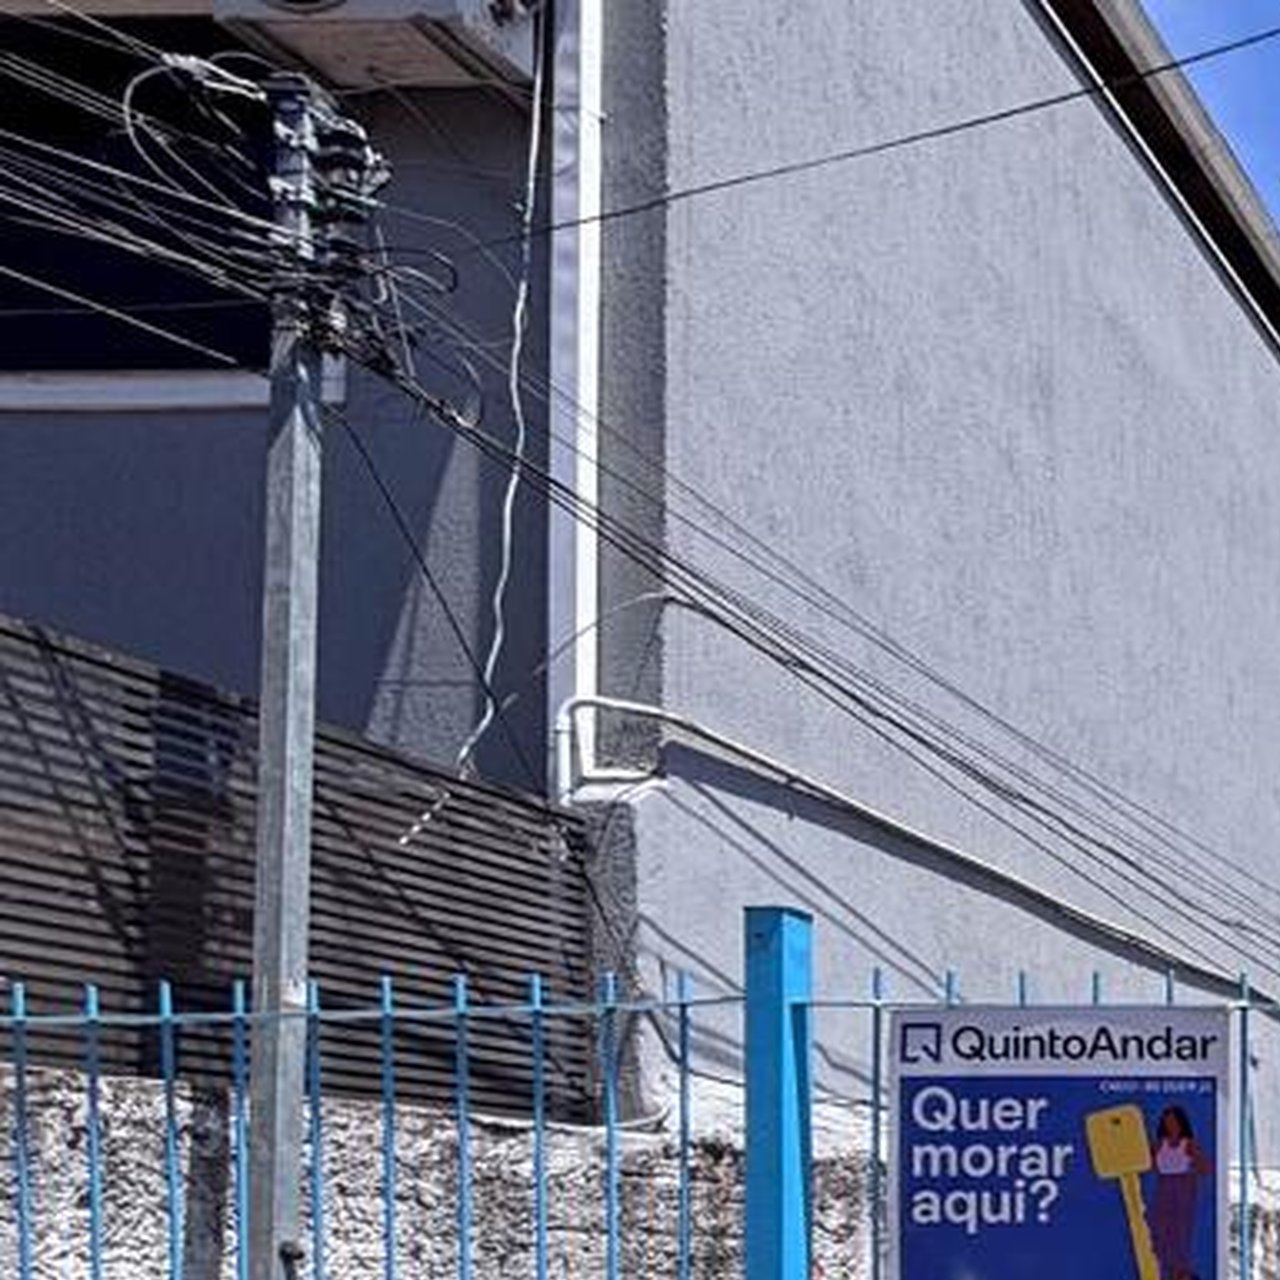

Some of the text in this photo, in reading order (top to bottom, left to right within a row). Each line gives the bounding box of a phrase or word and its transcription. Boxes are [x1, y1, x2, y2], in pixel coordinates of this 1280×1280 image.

[951, 1025, 1219, 1062] QuintoAndar
[912, 1086, 1048, 1132] Quer
[912, 1144, 1074, 1178] morar
[912, 1179, 1059, 1235] aqui?
